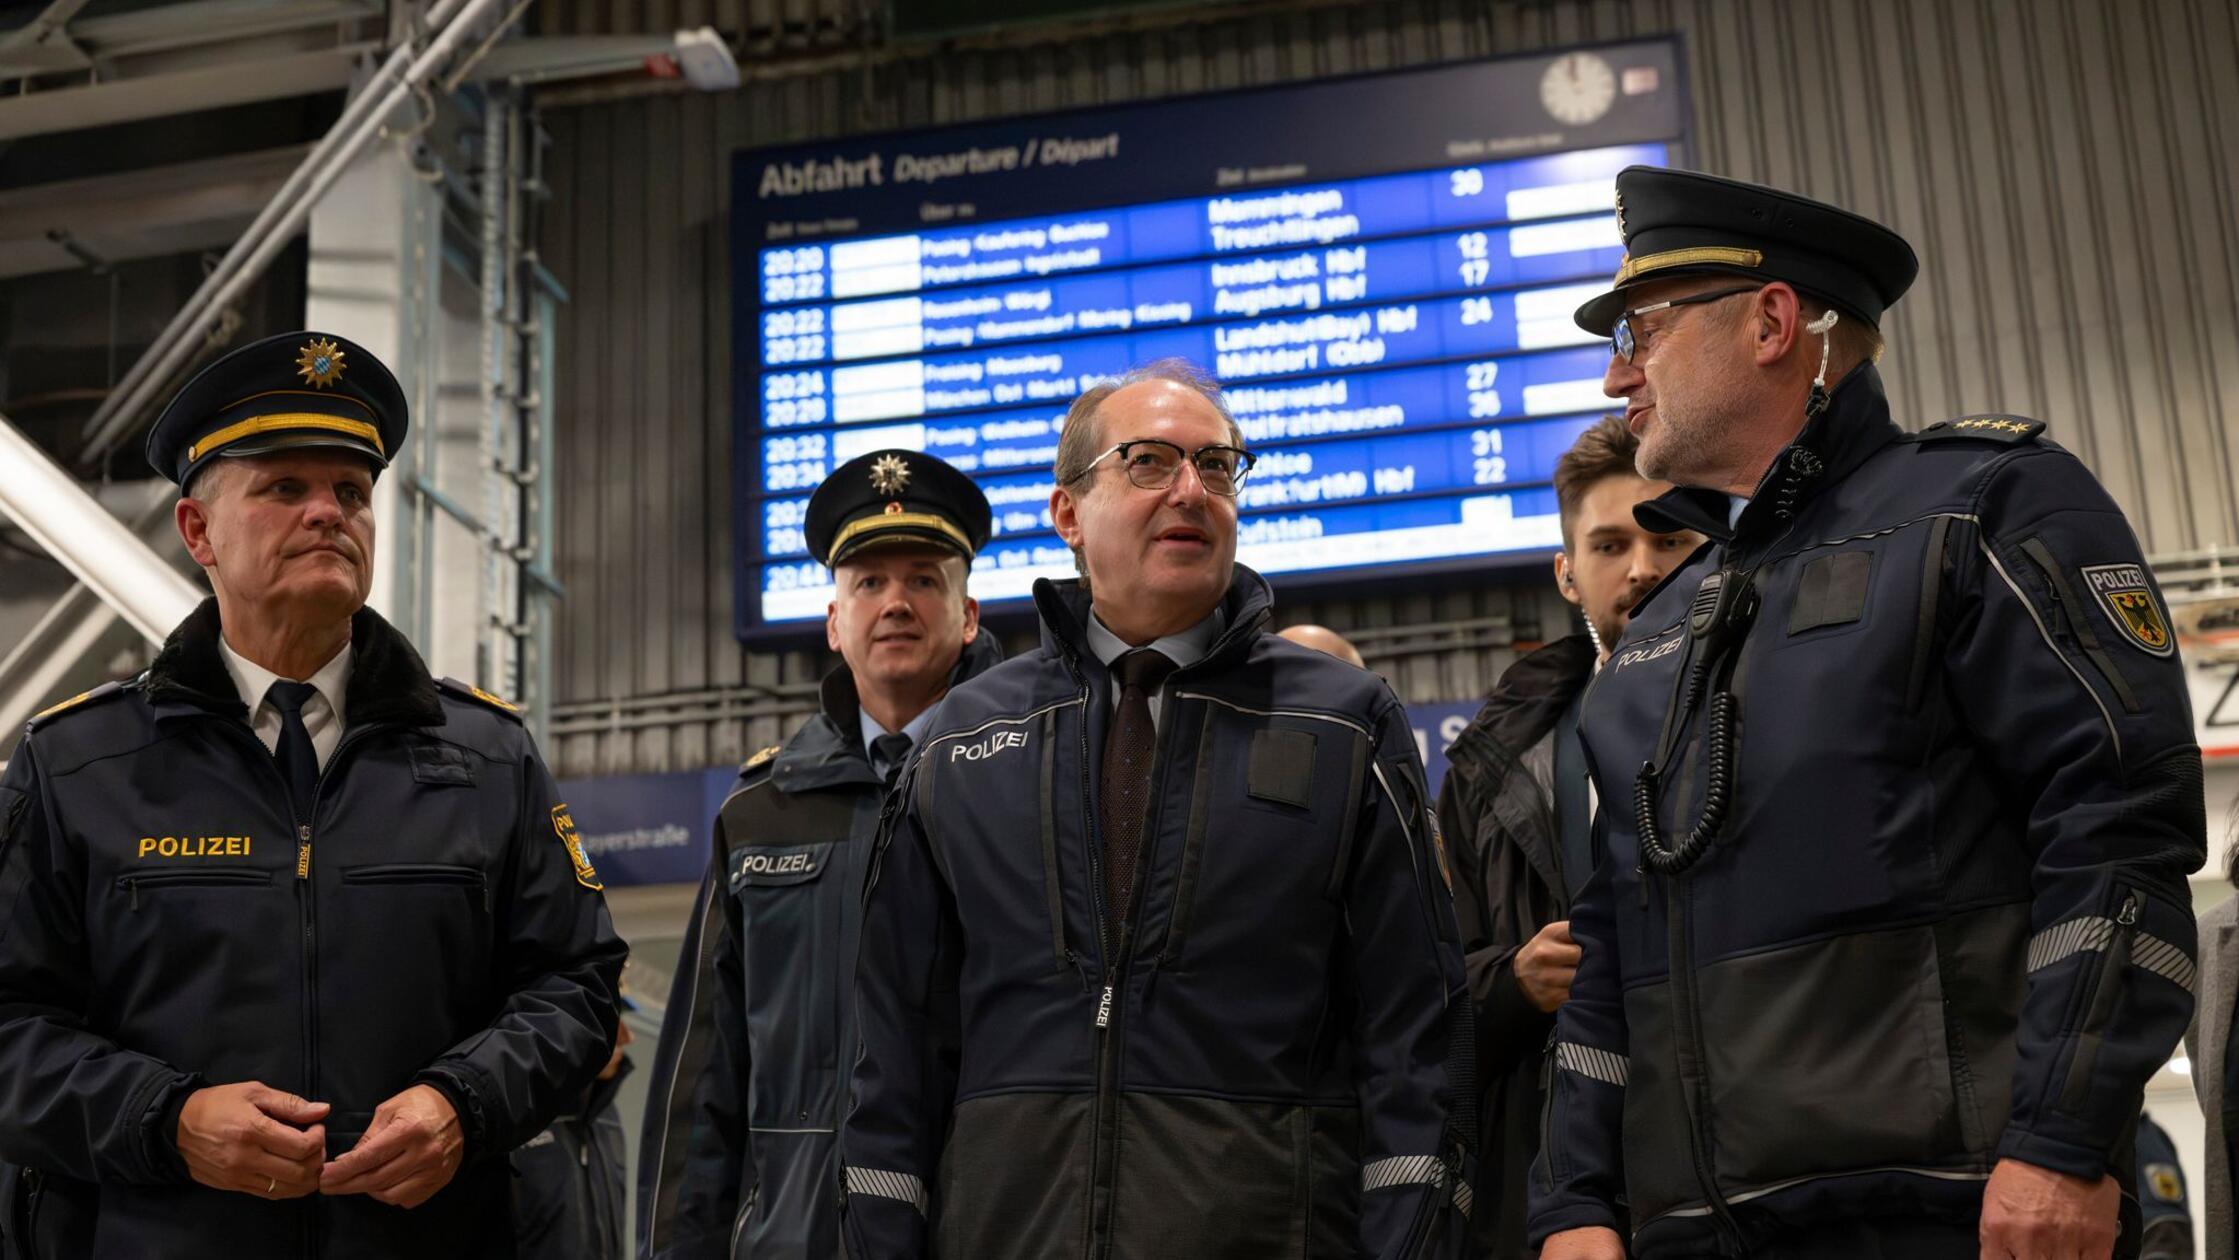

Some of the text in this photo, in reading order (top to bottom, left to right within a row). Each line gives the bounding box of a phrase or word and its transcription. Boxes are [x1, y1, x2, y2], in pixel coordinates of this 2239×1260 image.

[759, 153, 884, 198] Abfahrt
[893, 147, 1019, 184] Departure
[1458, 233, 1487, 259] 12
[1212, 253, 1318, 286] Innsbruck
[1459, 259, 1489, 285] 17
[1215, 283, 1320, 315] Augsburg
[1466, 362, 1497, 390] 27
[1472, 430, 1502, 457] 31
[2090, 570, 2146, 591] POLIZEI
[1614, 633, 1686, 675] POLIZEI
[951, 731, 1028, 763] POLIZEI
[138, 836, 252, 859] POLIZEI
[584, 823, 689, 858] ayerstraße
[297, 845, 309, 876] POLIZEI
[742, 853, 808, 875] POLIZEI
[1096, 986, 1112, 1027] POLIZEI
